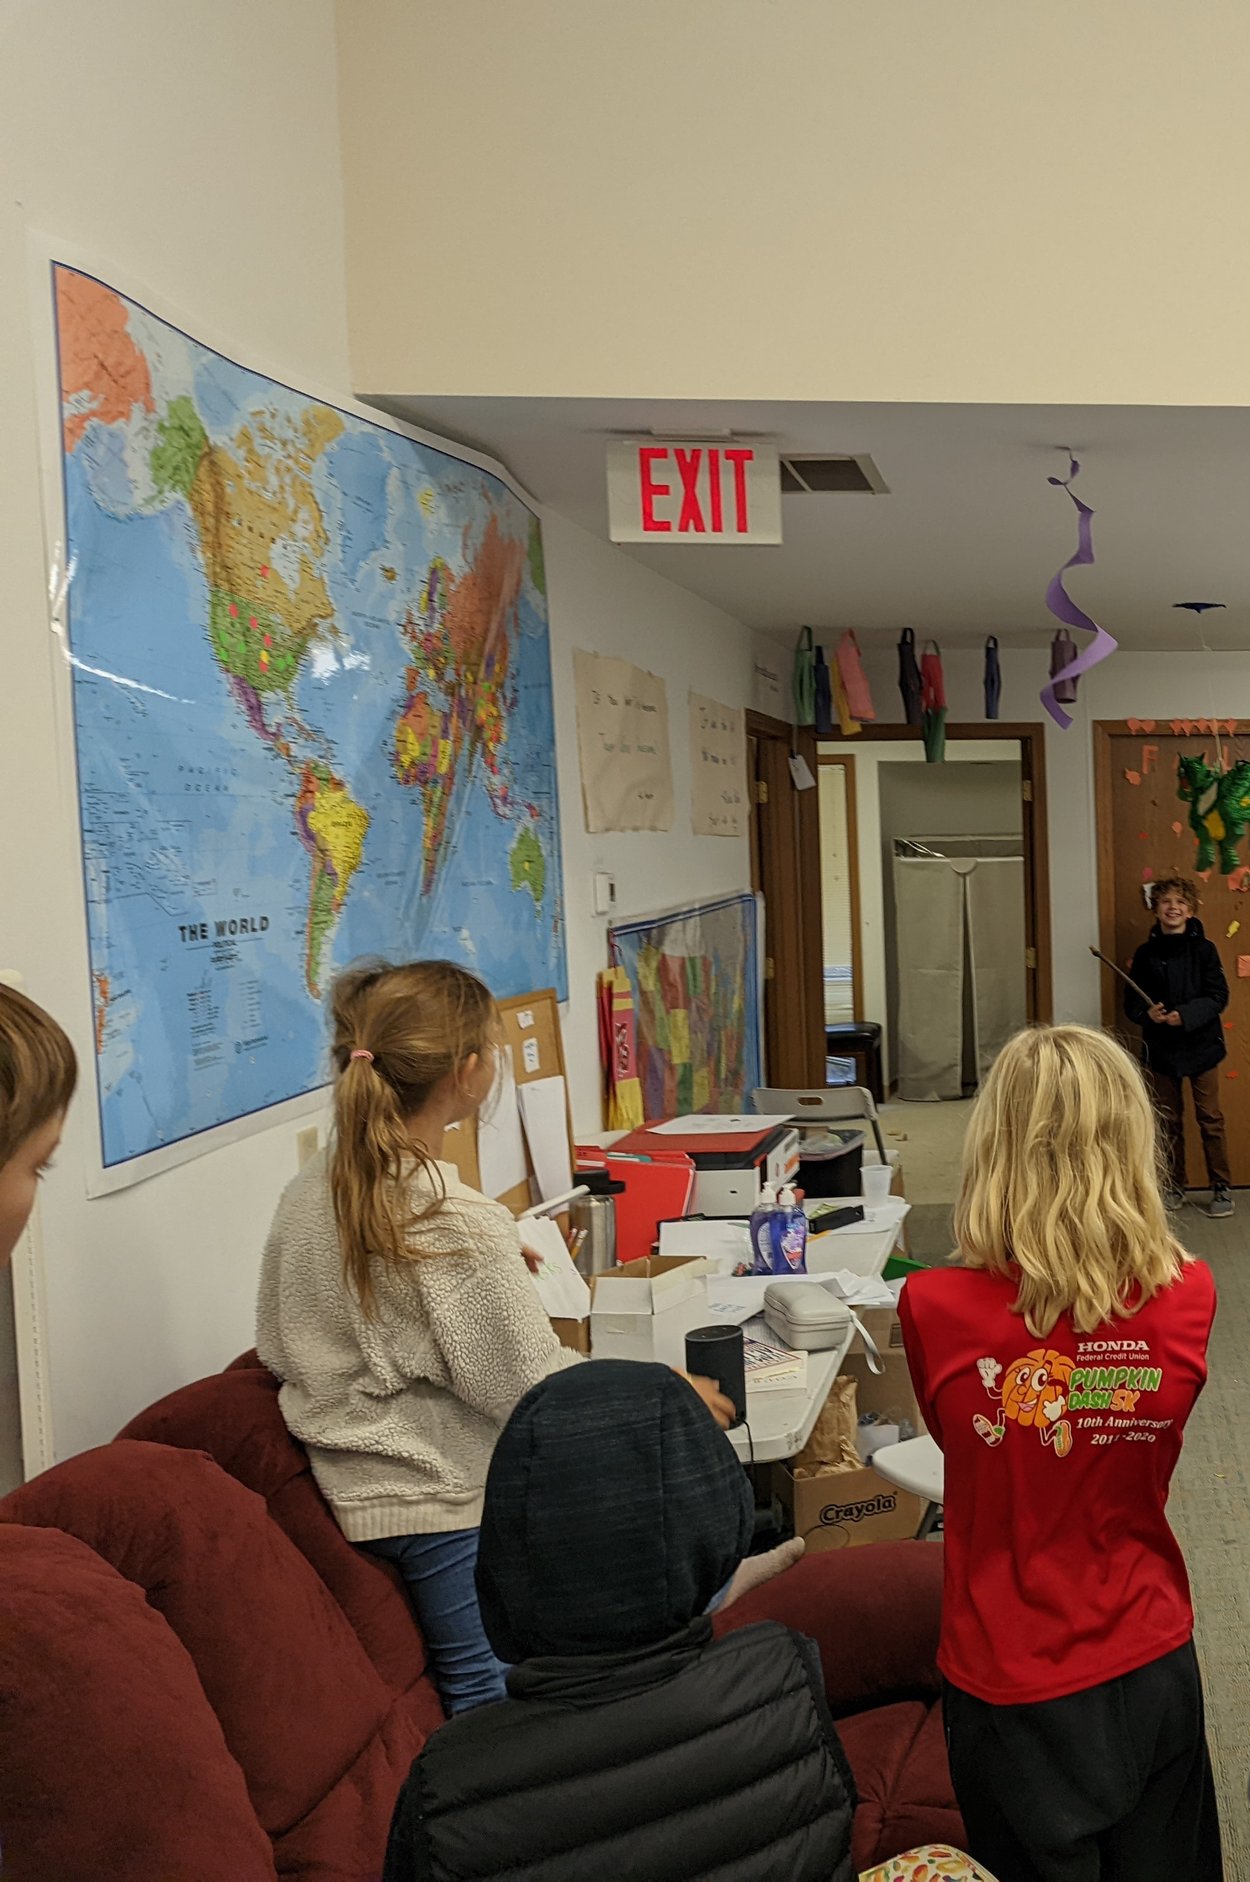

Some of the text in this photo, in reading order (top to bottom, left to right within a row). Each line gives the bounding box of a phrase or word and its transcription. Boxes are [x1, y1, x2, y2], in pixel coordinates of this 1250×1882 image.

[638, 446, 754, 534] EXIT
[178, 916, 270, 943] THE WORLD
[1076, 1352, 1150, 1362] Federal Credit Union
[1077, 1340, 1150, 1353] HONDA
[1069, 1366, 1162, 1392] PUMPKIN
[1068, 1390, 1112, 1411] DASH
[1076, 1415, 1175, 1430] 10th Anniversary
[820, 1494, 896, 1526] Crayola
